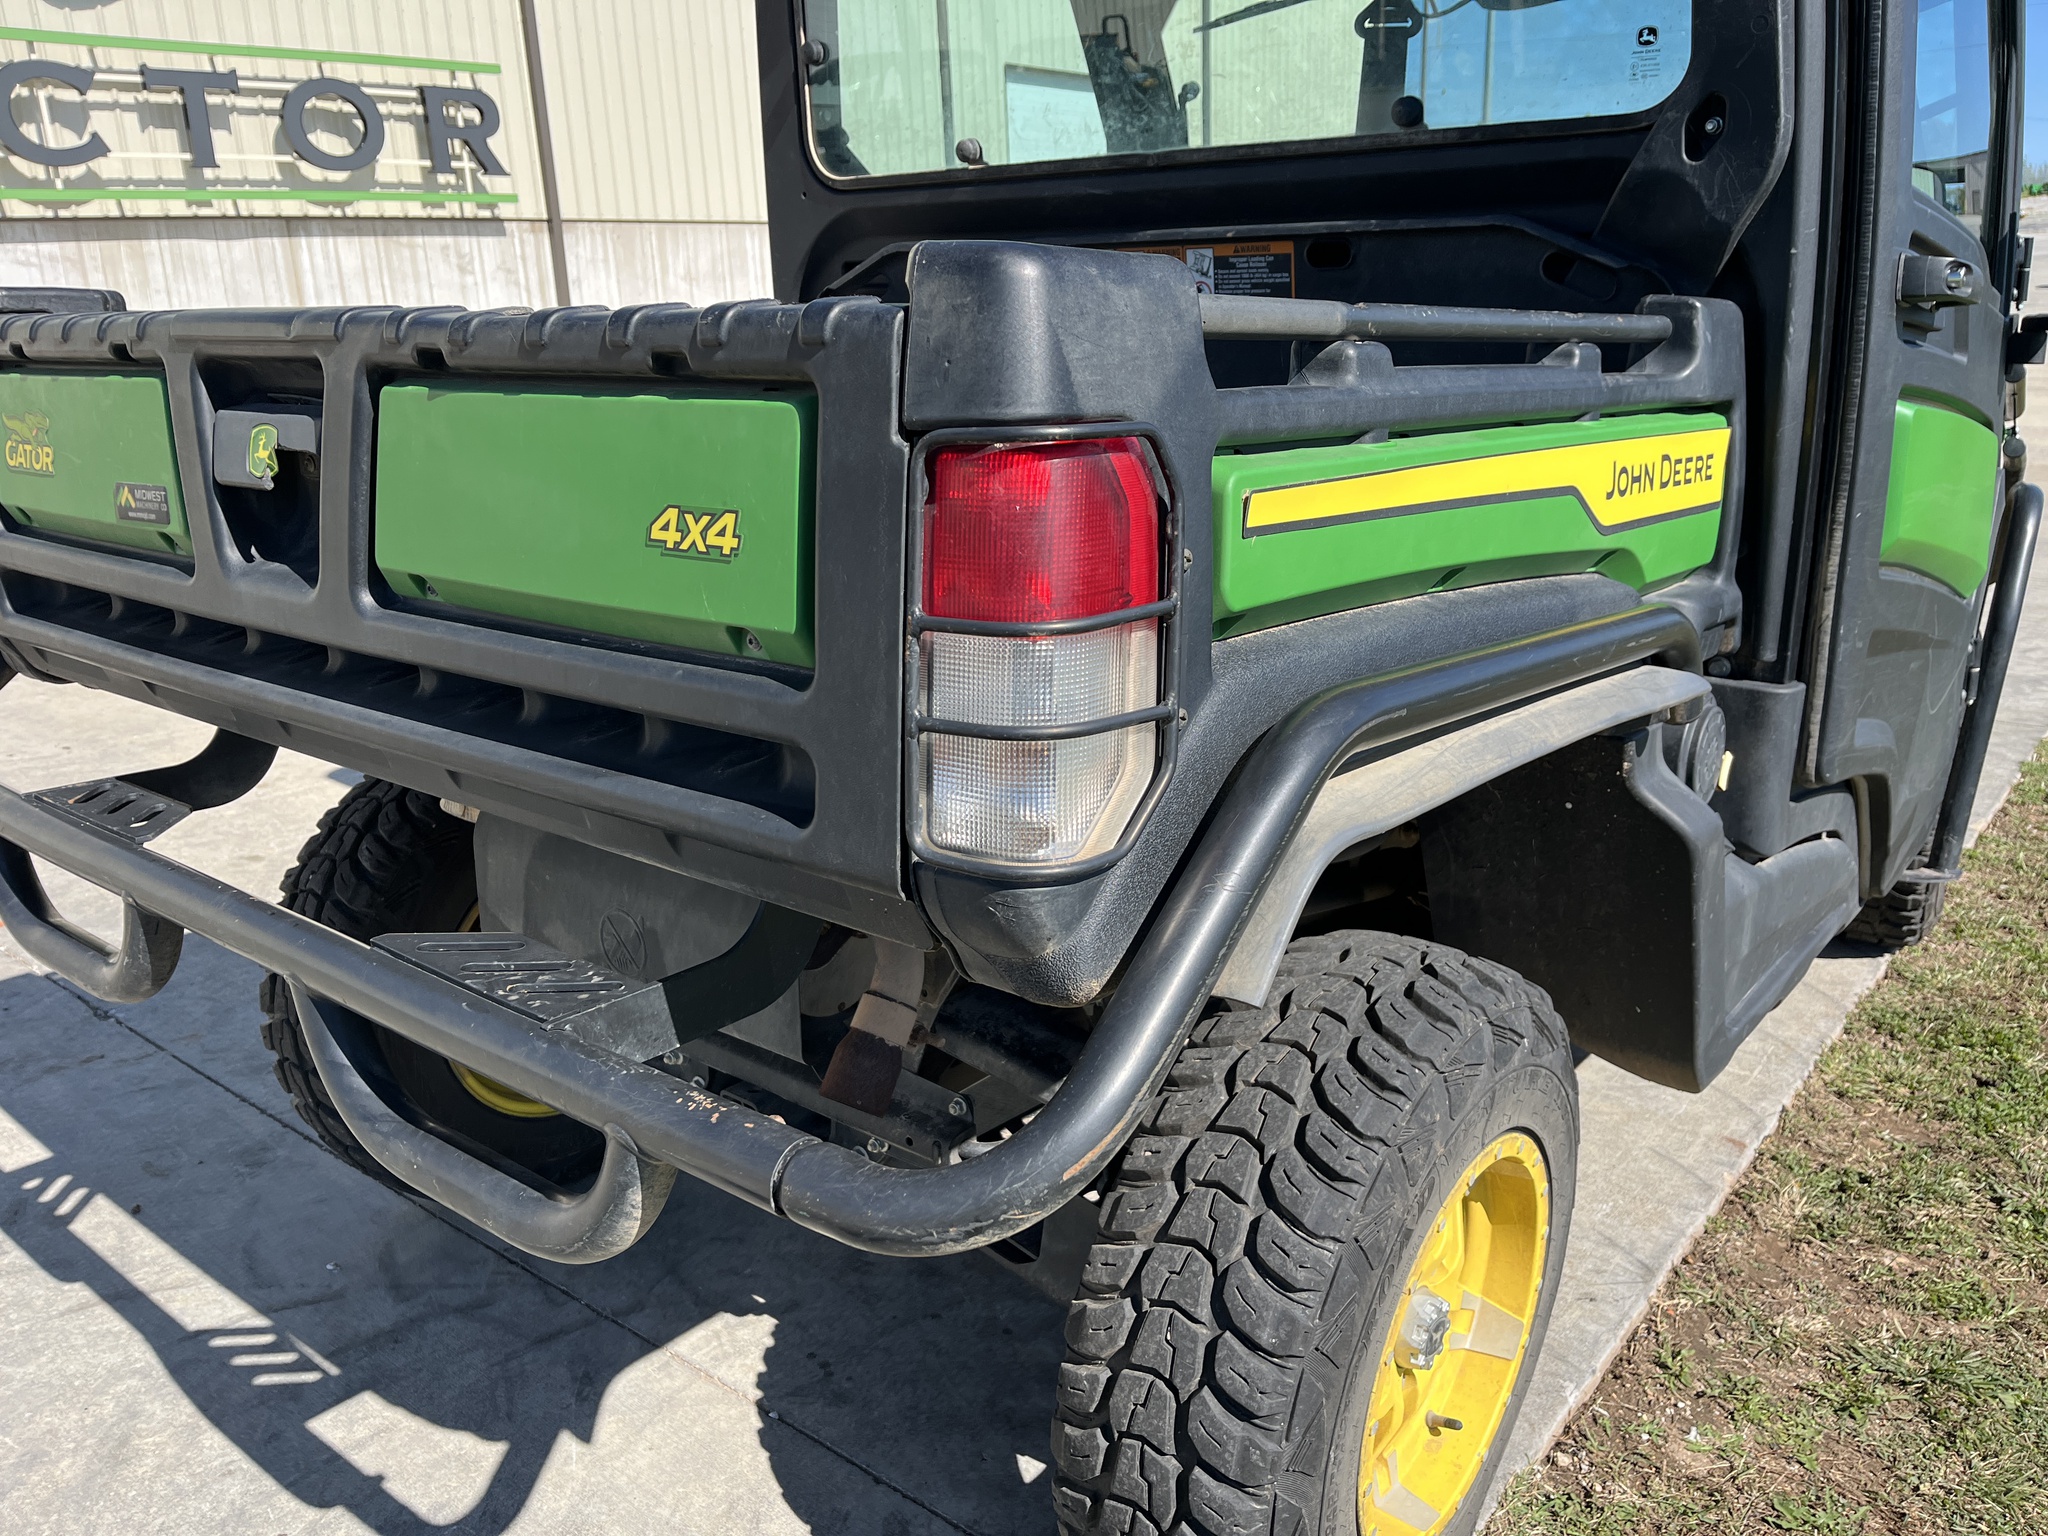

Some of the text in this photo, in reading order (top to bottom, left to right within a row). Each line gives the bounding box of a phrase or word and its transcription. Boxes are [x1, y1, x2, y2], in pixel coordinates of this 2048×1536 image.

[1241, 244, 1271, 253] WARNING
[5, 440, 54, 473] GATOR
[1605, 453, 1714, 501] JOHN DEERE
[134, 489, 166, 502] MIDWEST
